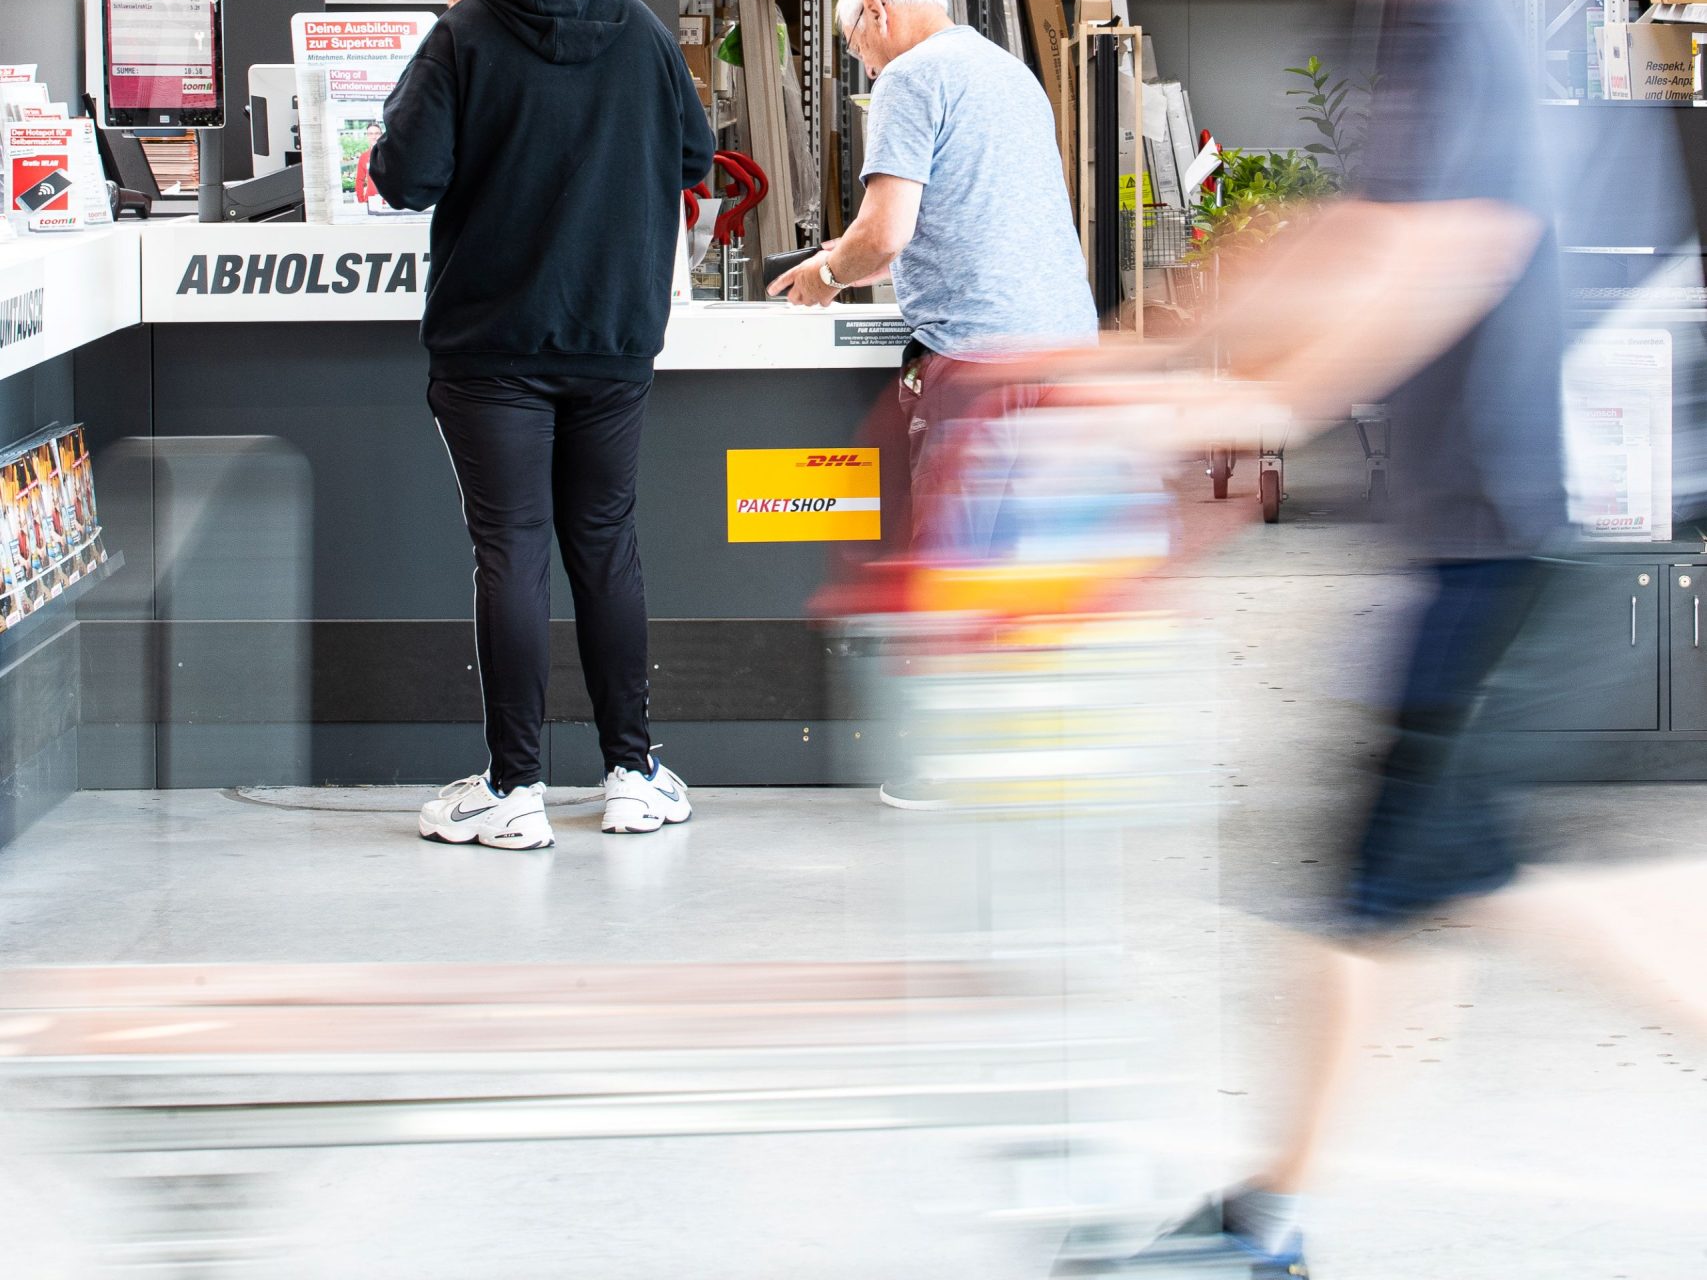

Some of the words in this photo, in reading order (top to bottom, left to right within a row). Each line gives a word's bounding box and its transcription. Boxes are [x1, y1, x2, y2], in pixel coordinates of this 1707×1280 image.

[307, 23, 341, 34] Deine
[344, 23, 410, 35] Ausbildung
[309, 39, 328, 48] zur
[330, 37, 394, 50] Superkraft
[1048, 29, 1060, 57] LECO
[116, 67, 139, 75] SUMME:
[1645, 61, 1685, 72] Respekt,
[1645, 76, 1694, 87] Alles-Anpa
[1645, 90, 1664, 100] und
[1665, 90, 1694, 100] Umwe
[176, 252, 431, 295] ABHOLSTA
[806, 455, 862, 467] DHL
[738, 498, 837, 513] PAKETSHOP
